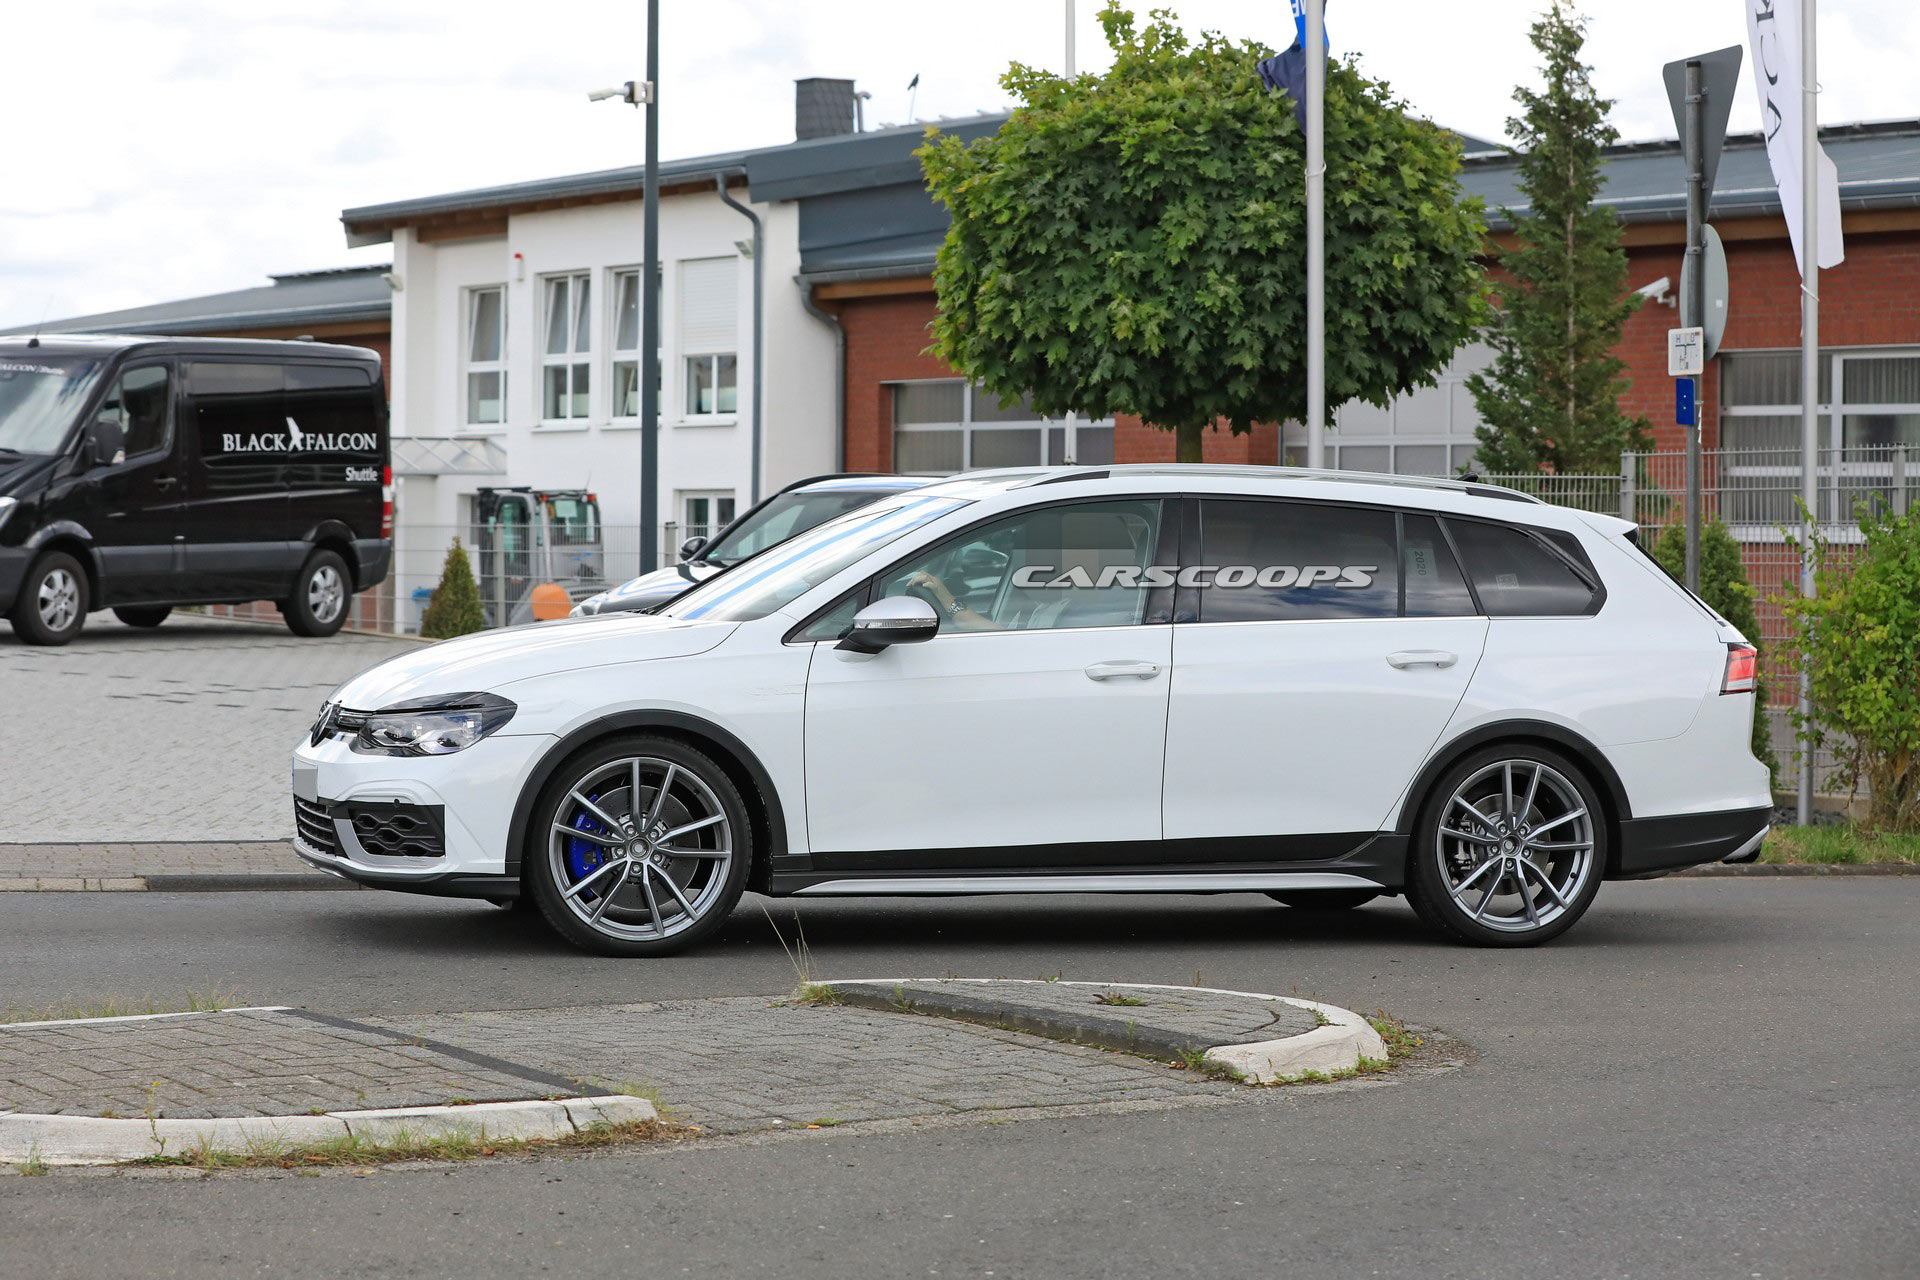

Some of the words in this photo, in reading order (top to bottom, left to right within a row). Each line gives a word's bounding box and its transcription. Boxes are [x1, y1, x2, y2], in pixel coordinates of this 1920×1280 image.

[222, 433, 287, 452] BLACK
[306, 433, 377, 450] FALCON
[345, 466, 378, 482] Shuttle
[1414, 551, 1427, 576] 2020
